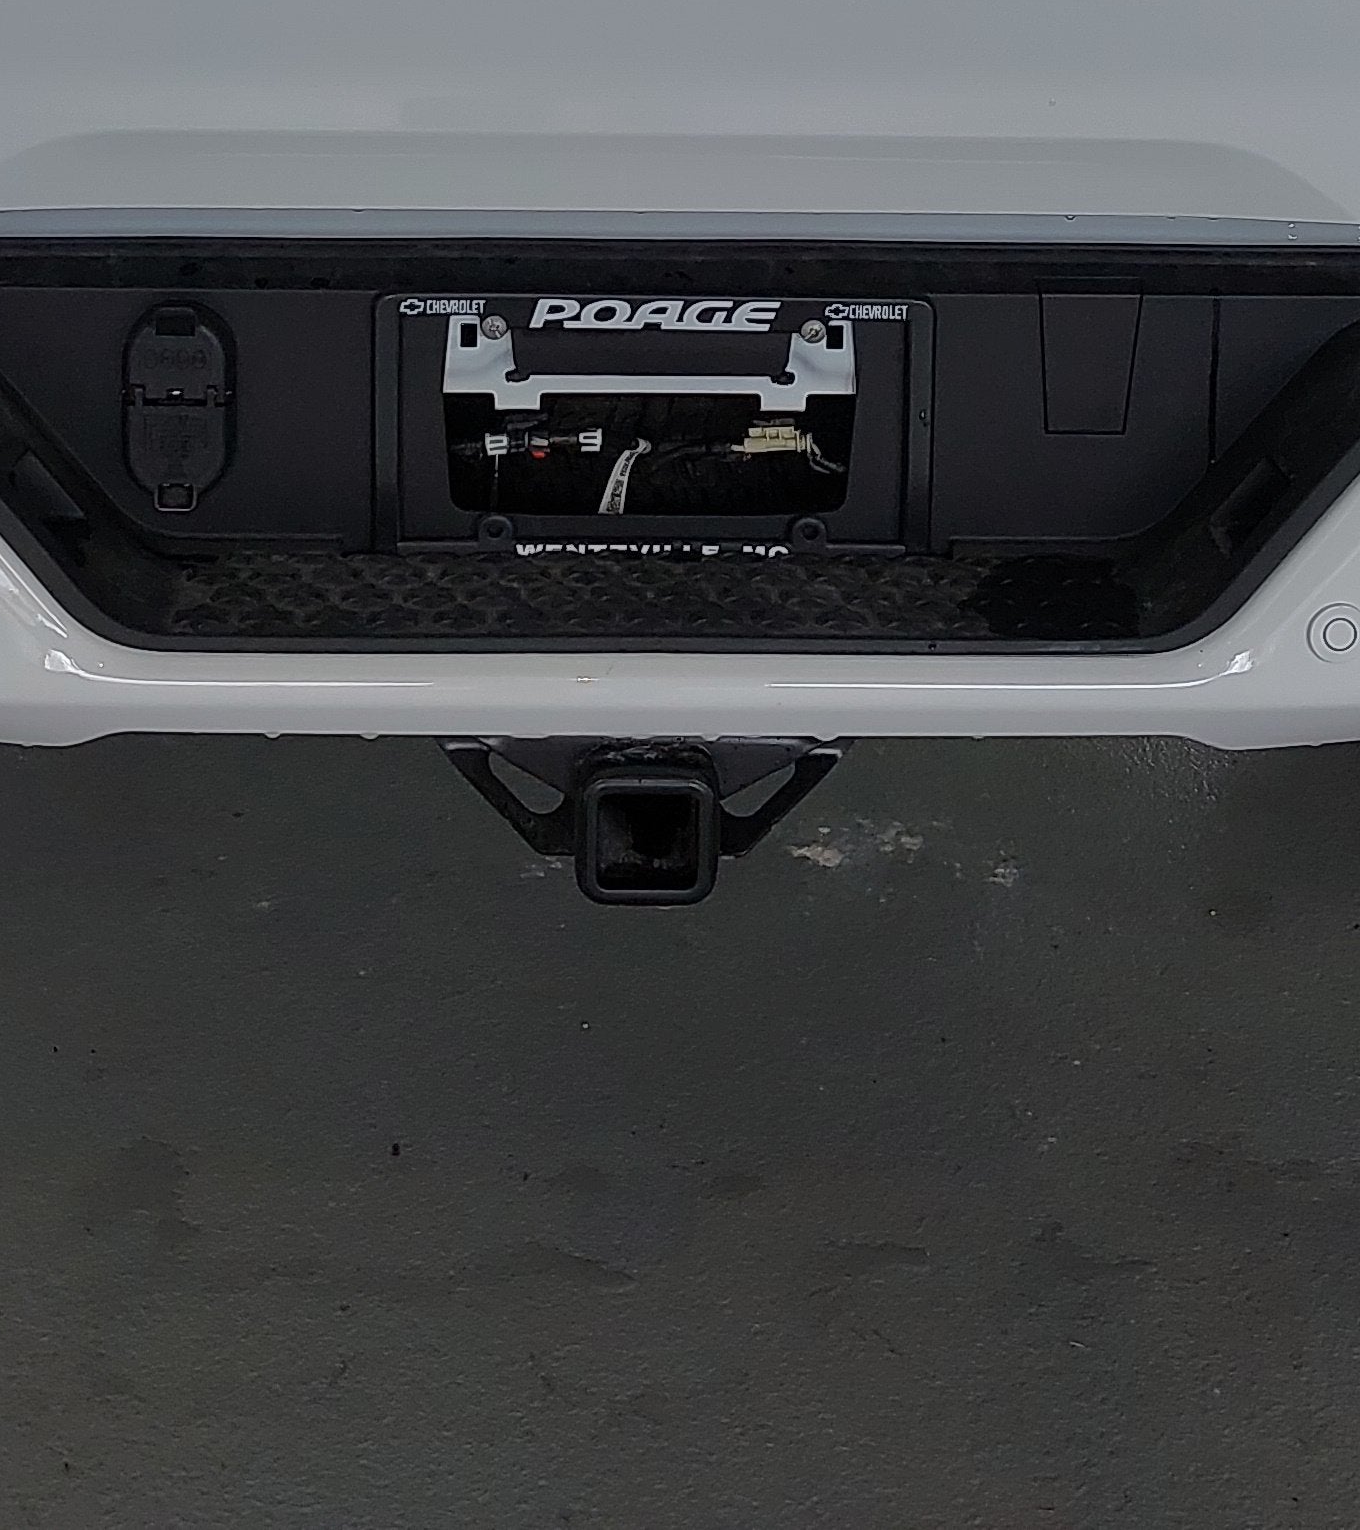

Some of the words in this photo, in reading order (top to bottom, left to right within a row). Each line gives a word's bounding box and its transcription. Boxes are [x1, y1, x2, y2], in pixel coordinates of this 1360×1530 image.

[426, 299, 487, 315] CHEVROLET
[529, 298, 782, 332] POAGE
[848, 304, 909, 320] CHEVROLET
